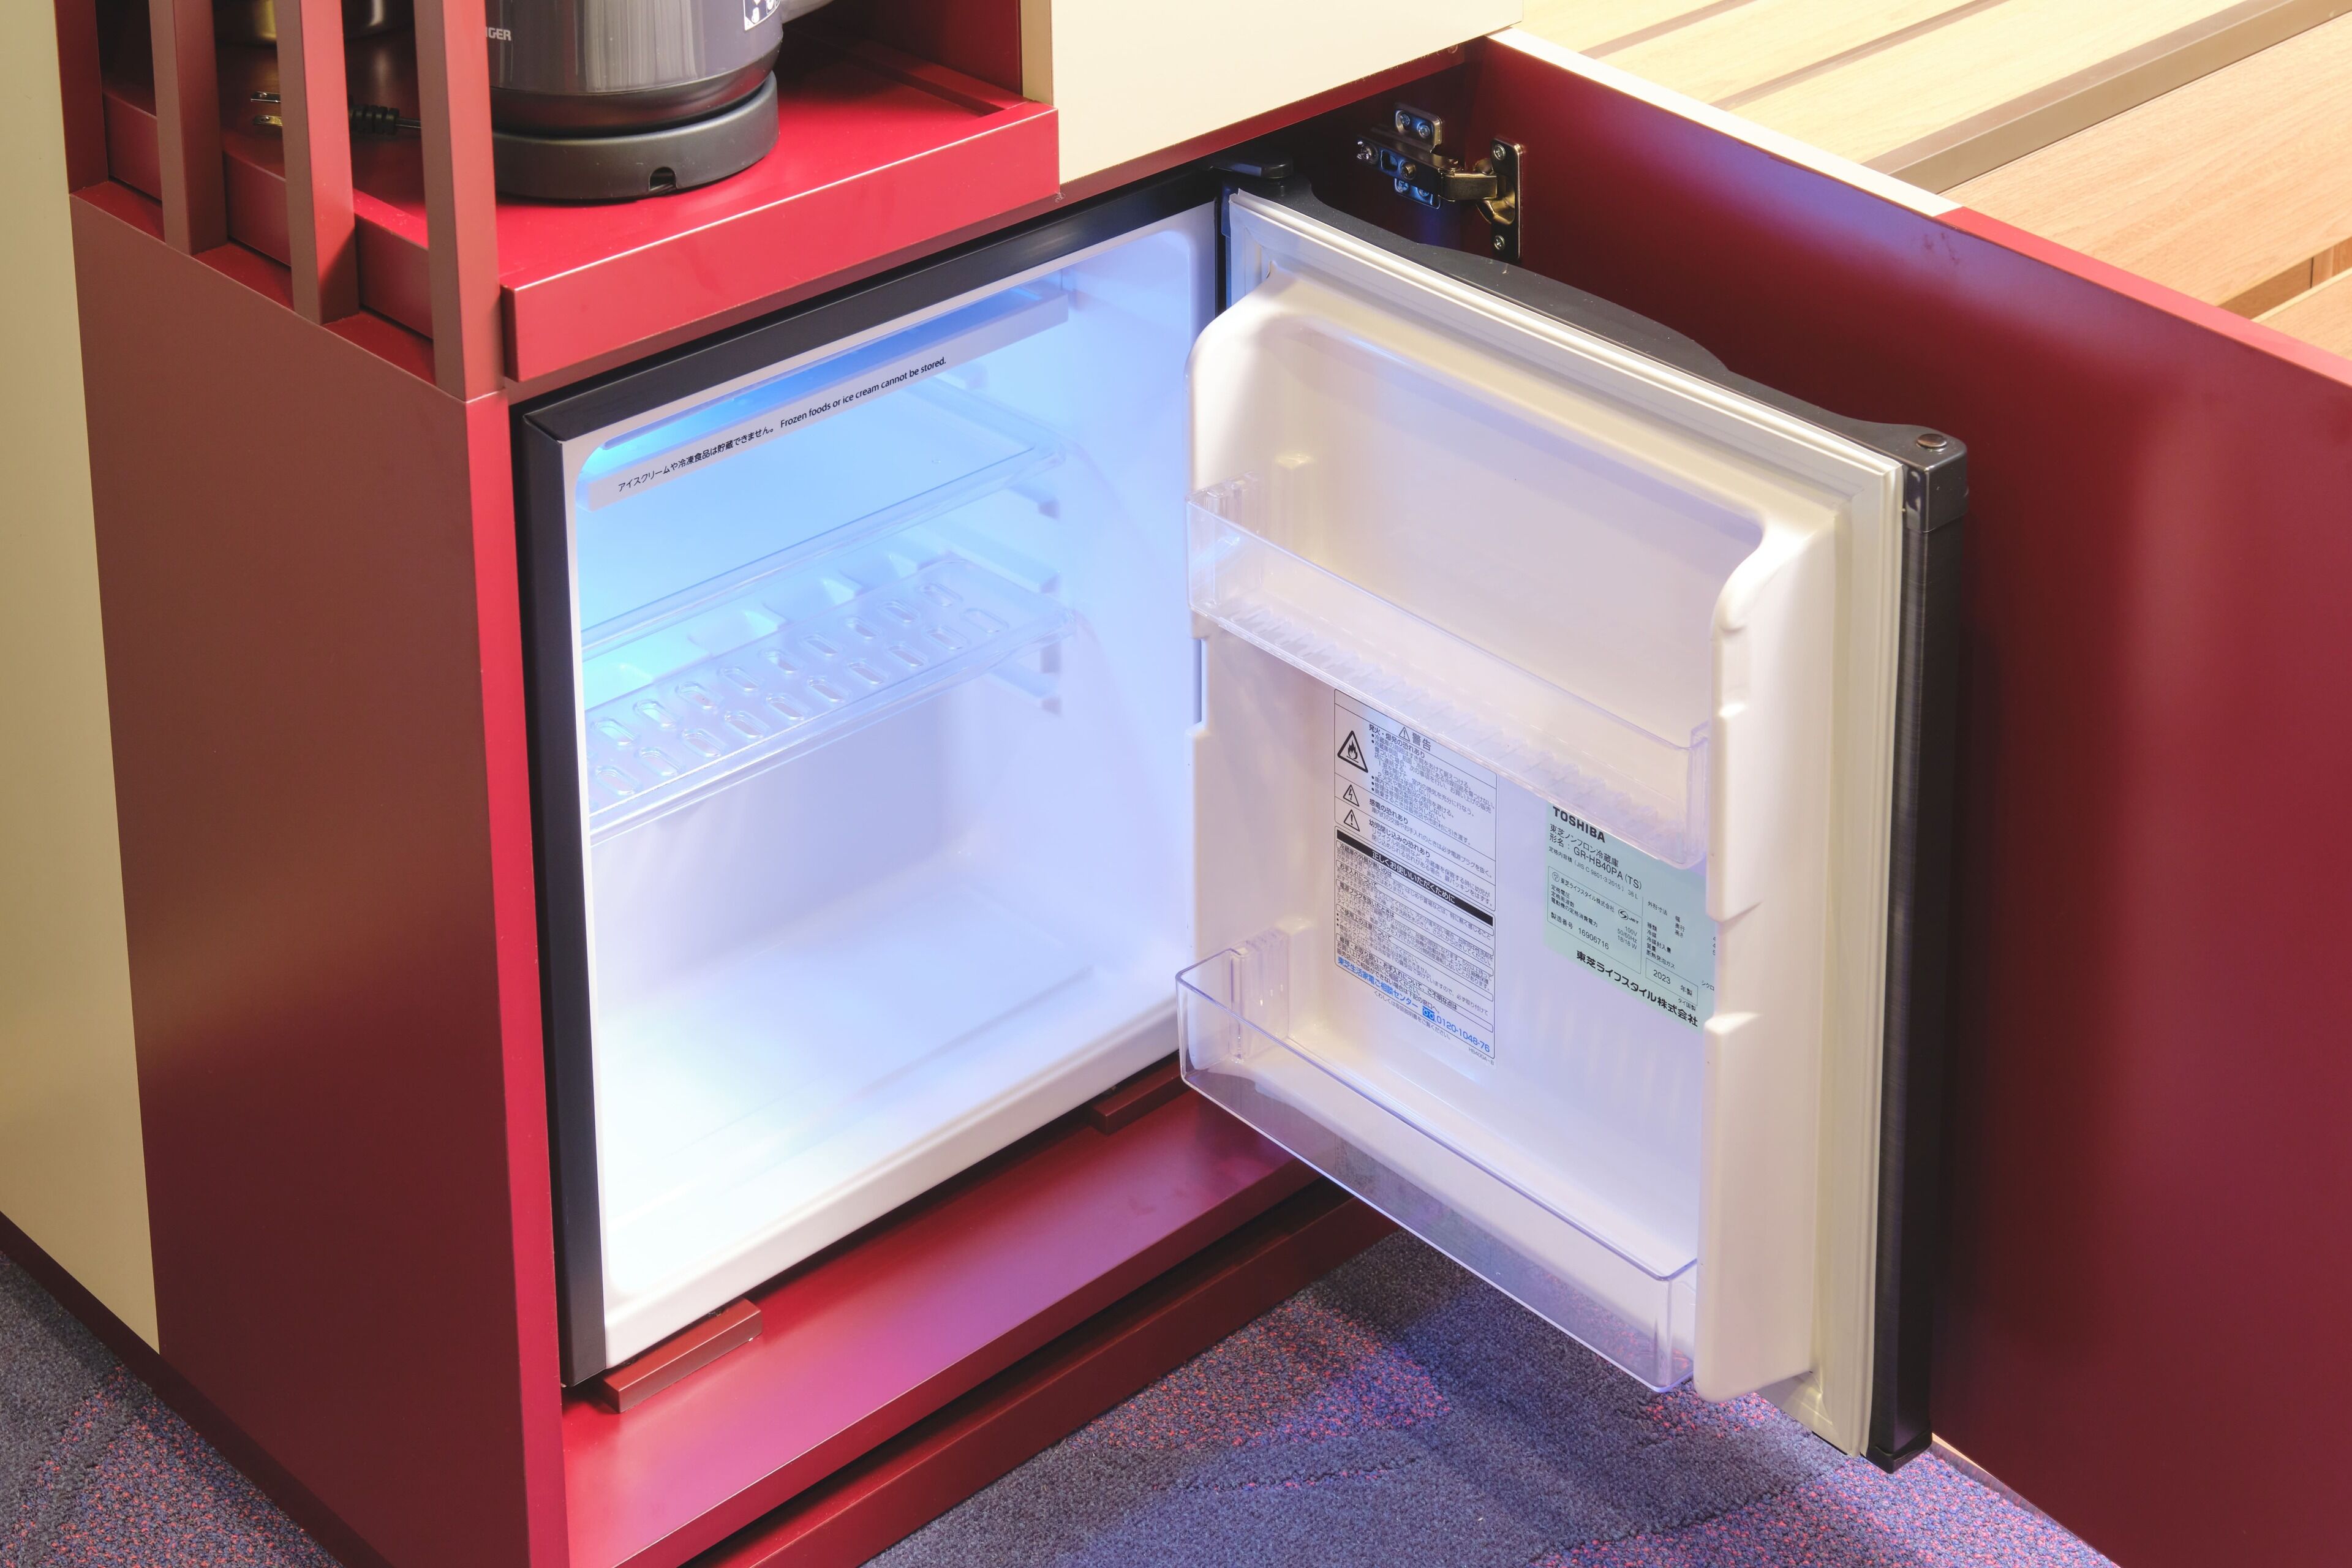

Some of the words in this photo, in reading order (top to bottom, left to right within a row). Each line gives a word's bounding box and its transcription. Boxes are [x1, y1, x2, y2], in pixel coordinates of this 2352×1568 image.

[485, 26, 511, 41] IGER
[618, 426, 774, 492] アイスクリームや冷凍食品は貯蔵できません。
[780, 412, 807, 428] Frozen
[809, 402, 831, 417] foods
[832, 398, 841, 408] or
[843, 394, 854, 404] ice
[855, 384, 880, 399] cream
[881, 372, 908, 388] cannot
[909, 368, 919, 378] be
[921, 357, 946, 373] stored.
[1412, 731, 1431, 752] 警告
[1369, 797, 1408, 825] 感電の恐れあり
[1553, 805, 1605, 843] TOSHIBA
[1368, 818, 1430, 859] 幼児閉じ込みの恐れあり
[1549, 822, 1618, 869] 東芝ノンフロン冷蔵庫
[1340, 861, 1377, 889] お手入れについて
[1372, 850, 1455, 905] 正しくお使いいただくために
[1551, 883, 1570, 900] 定格電圧
[1551, 890, 1574, 908] 定格周波数
[1560, 876, 1615, 913] 東芝ライフスタイル株式会社
[1551, 896, 1597, 928] 電動機の定格消費電力
[1550, 911, 1573, 930] 製造番号
[1578, 927, 1609, 951] 16906716
[1617, 927, 1637, 944] 50/60Hz
[1625, 925, 1637, 937] 100V
[1576, 949, 1698, 1028] 東芝ライフスタイル株式会社
[1653, 968, 1670, 985] 2023
[1680, 984, 1692, 997] 年製
[1338, 955, 1418, 1011] 東芝生活家電ご相談センター
[1436, 1014, 1490, 1054] 0120-1048-76
[1678, 997, 1695, 1012] タイ国製
